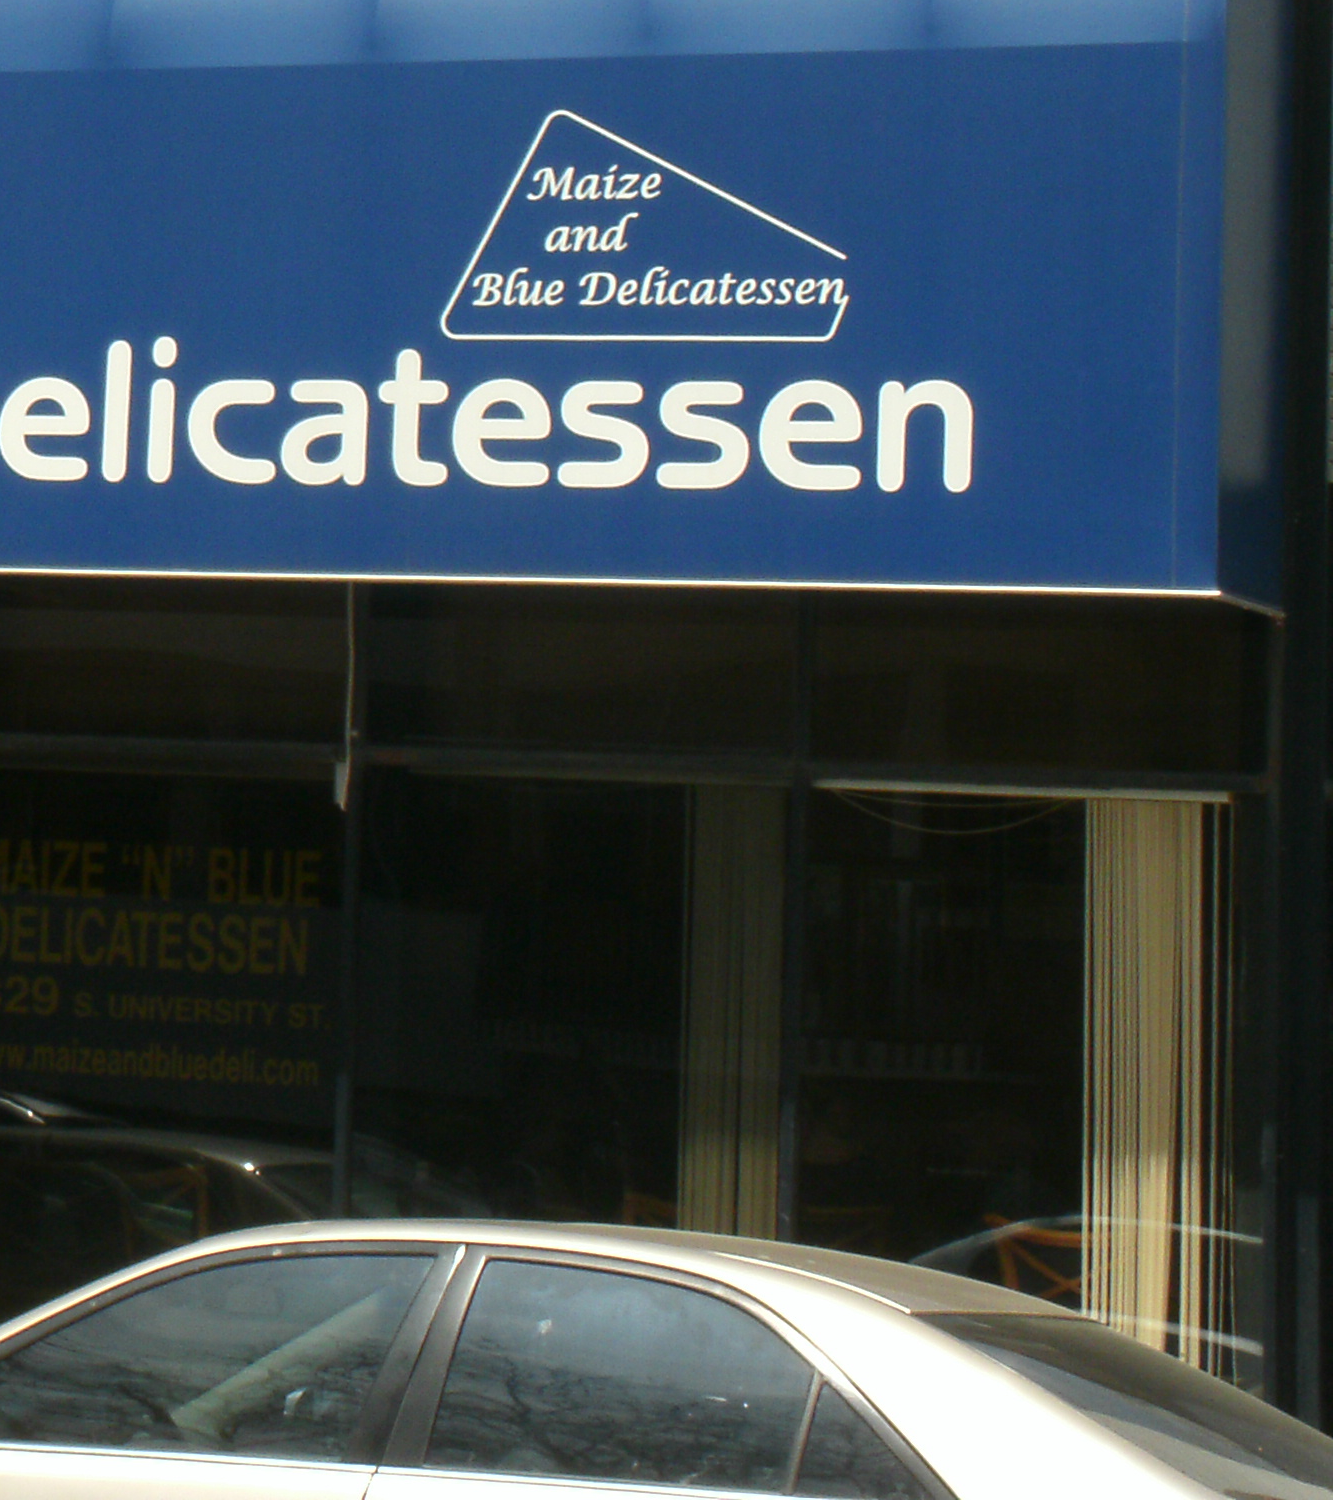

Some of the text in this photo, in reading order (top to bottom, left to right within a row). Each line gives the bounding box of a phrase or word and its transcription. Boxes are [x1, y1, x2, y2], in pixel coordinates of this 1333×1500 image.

[527, 164, 662, 201] Maize
[544, 212, 639, 252] and
[472, 266, 847, 306] Blue Delicatessen
[208, 847, 322, 908] BLUE
[108, 994, 278, 1025] UNIVERSITY
